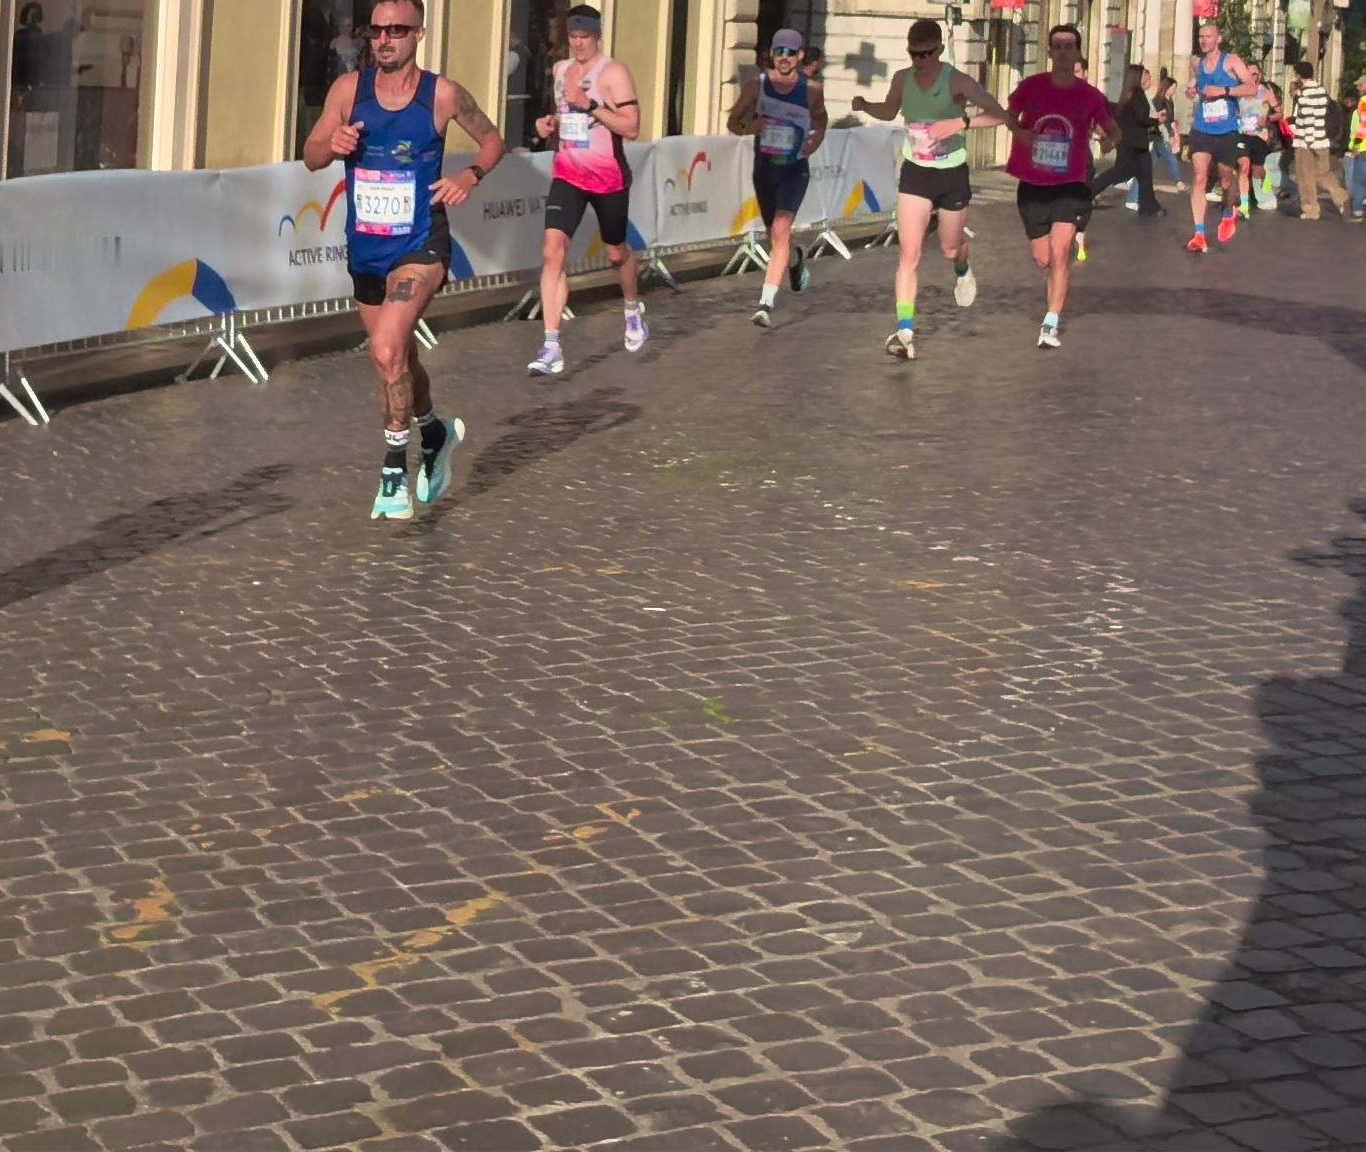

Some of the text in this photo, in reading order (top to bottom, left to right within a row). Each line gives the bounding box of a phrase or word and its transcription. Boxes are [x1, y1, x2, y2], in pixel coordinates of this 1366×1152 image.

[364, 195, 401, 215] 3270
[483, 199, 524, 221] HUAWEI
[289, 245, 348, 266] ACTIVE RING
